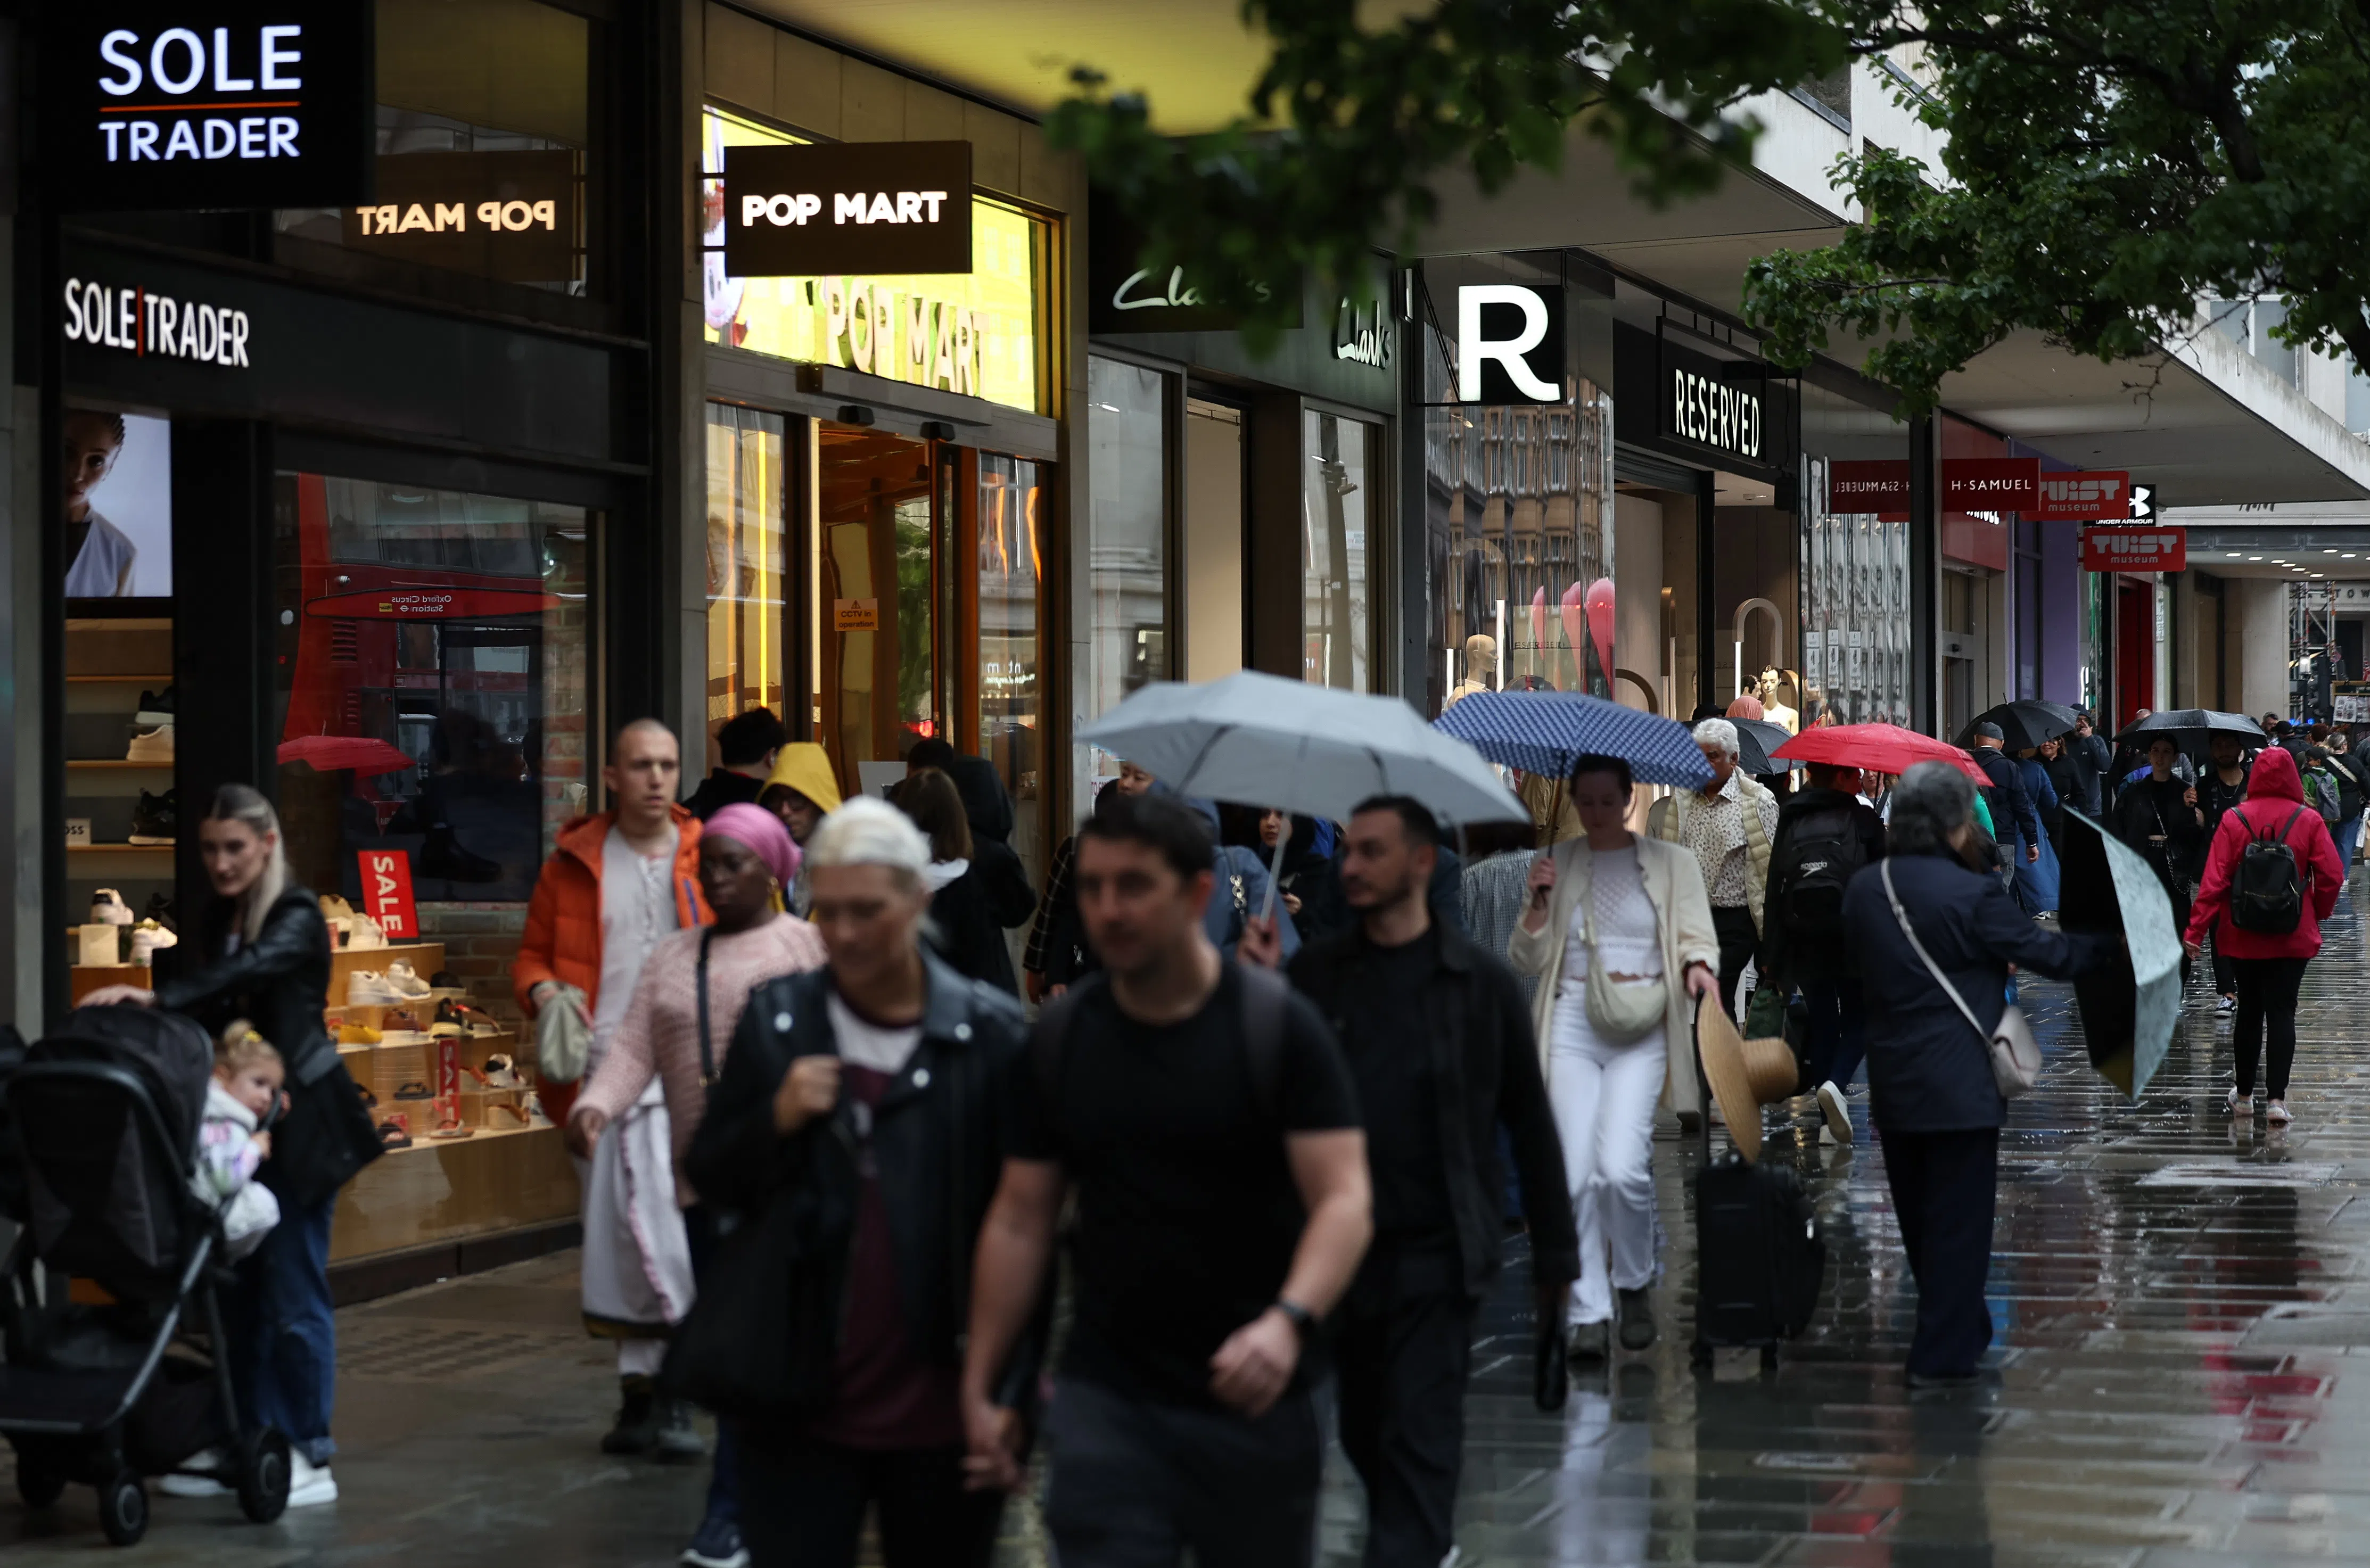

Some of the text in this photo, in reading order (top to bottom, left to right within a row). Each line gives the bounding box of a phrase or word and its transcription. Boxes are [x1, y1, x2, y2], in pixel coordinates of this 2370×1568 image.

[98, 25, 301, 96] SOLE
[98, 116, 300, 162] TRADER
[742, 191, 948, 227] POP MART
[64, 277, 249, 368] SOLE TRADER
[1113, 265, 1271, 310] Clas
[826, 276, 990, 399] POP MART
[1458, 285, 1560, 401] R
[1676, 369, 1759, 457] RESERVED
[2048, 503, 2100, 511] museum
[839, 621, 874, 629] operation
[373, 856, 403, 932] SALE
